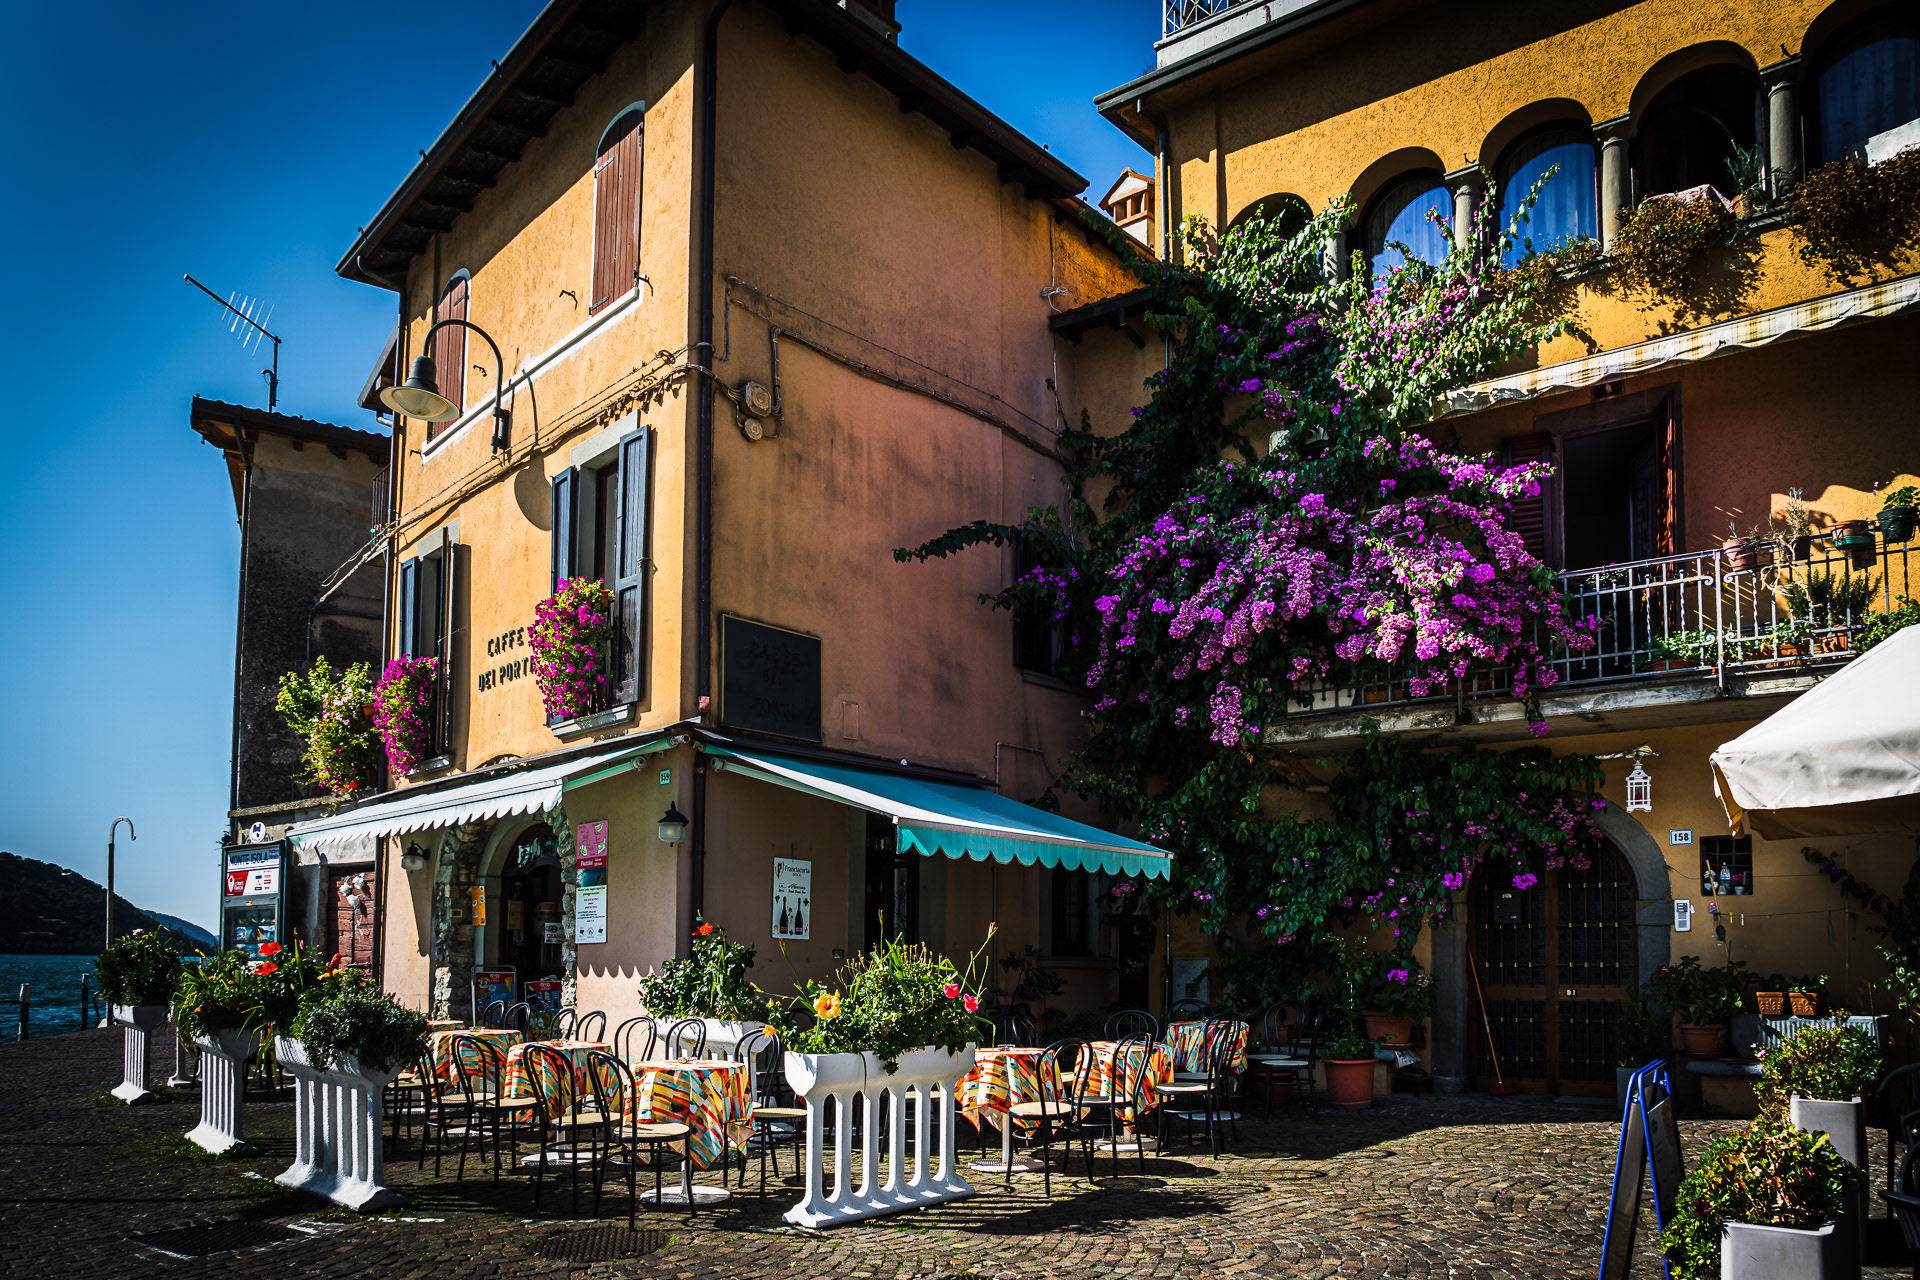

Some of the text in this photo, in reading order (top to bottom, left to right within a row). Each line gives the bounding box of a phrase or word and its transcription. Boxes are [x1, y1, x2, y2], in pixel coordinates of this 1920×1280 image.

[487, 626, 524, 657] CAFFE
[478, 669, 496, 692] DEI
[1673, 832, 1689, 842] 158
[229, 853, 250, 866] MONTE
[251, 851, 269, 864] ISOLA
[785, 865, 810, 874] Franciacorta
